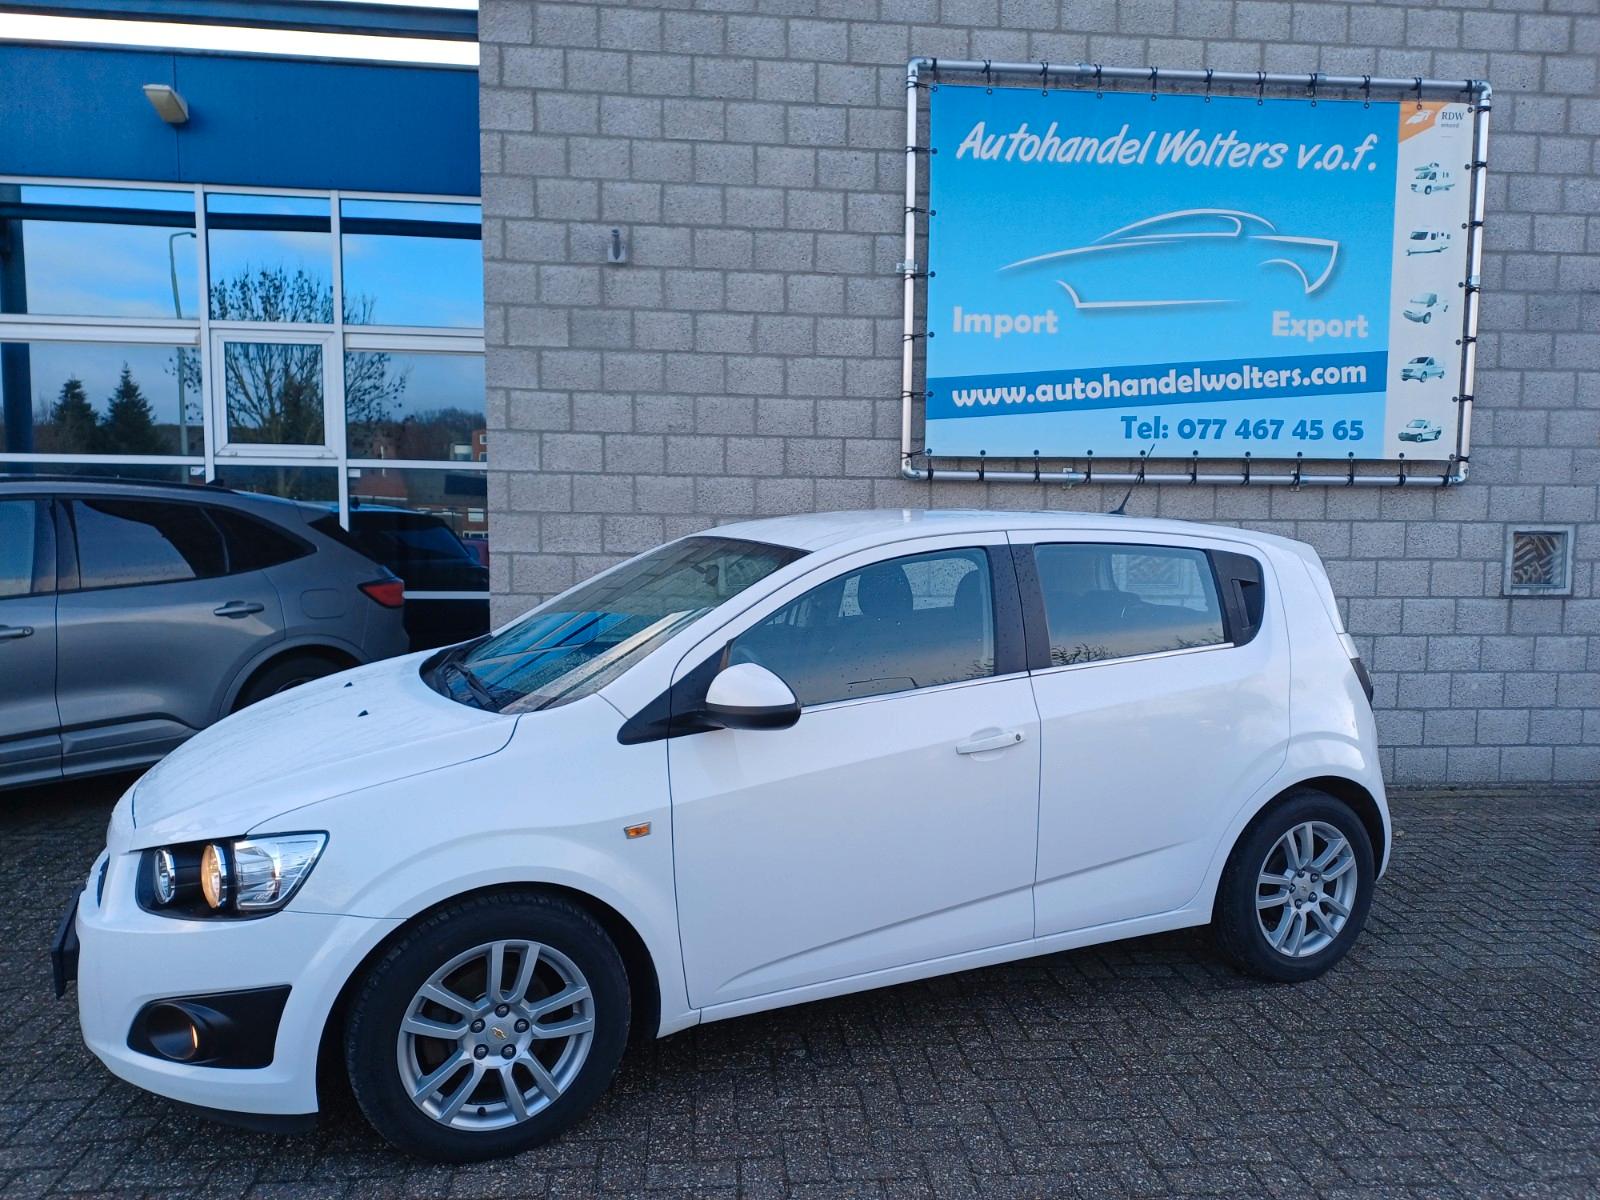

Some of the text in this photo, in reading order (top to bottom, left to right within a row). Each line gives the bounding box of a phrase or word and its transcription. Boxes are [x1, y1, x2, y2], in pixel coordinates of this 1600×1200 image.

[1441, 111, 1465, 121] RDW
[956, 121, 1378, 172] Autohandel Wolters v.o.f.
[952, 306, 1058, 338] Import
[1271, 311, 1369, 341] Export
[952, 364, 1367, 407] www.autohandelwolters.com
[1120, 415, 1364, 441] Tel: 077 467 45 65
